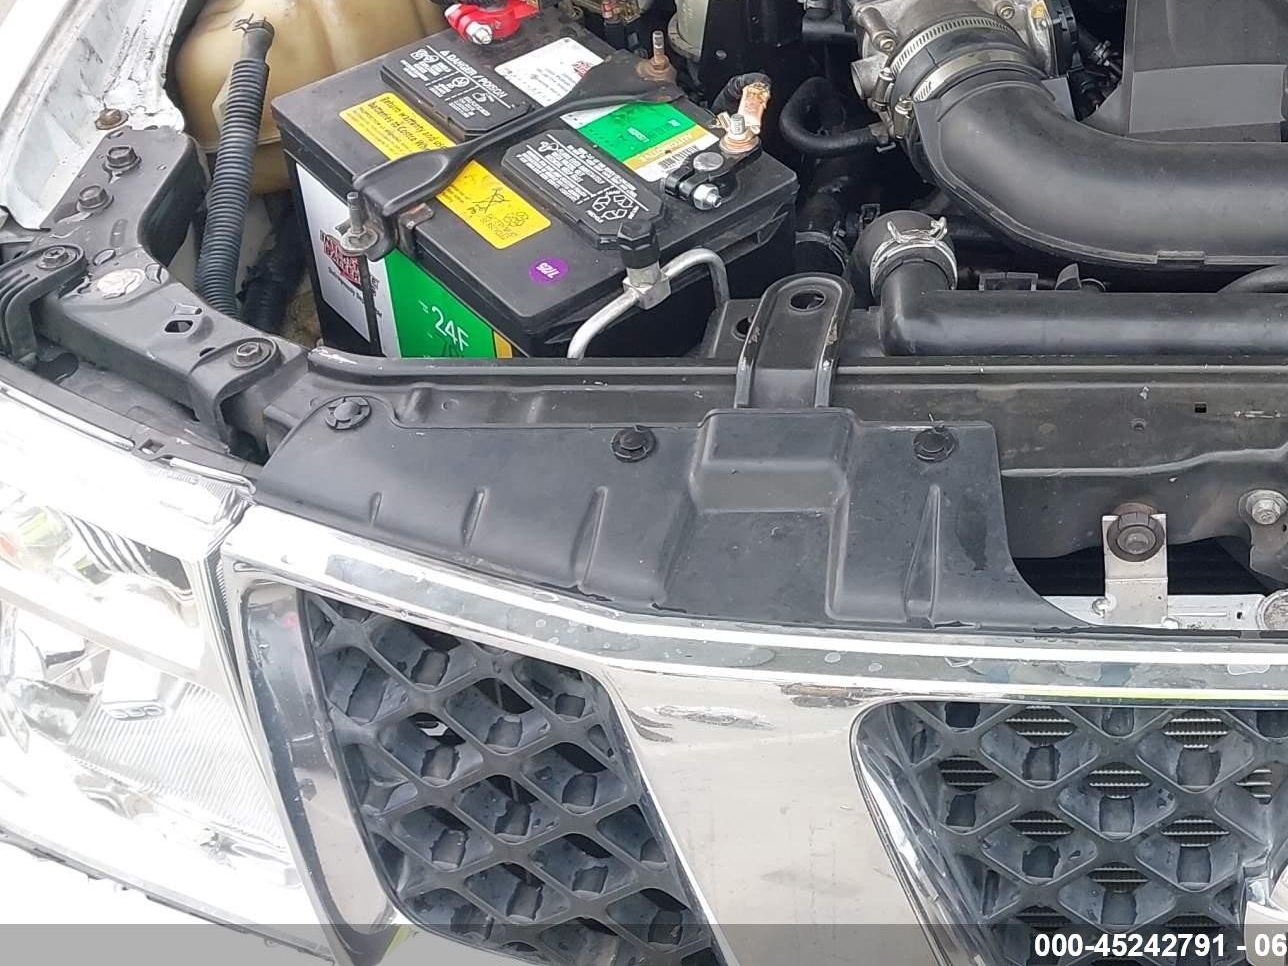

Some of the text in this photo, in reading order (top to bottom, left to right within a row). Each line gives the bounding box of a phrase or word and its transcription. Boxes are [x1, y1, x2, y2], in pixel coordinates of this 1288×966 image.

[446, 53, 478, 76] DANGER
[477, 77, 509, 99] POISON
[381, 96, 401, 112] Return
[399, 112, 424, 133] warranty
[396, 125, 418, 143] Costco
[431, 305, 469, 351] 24F
